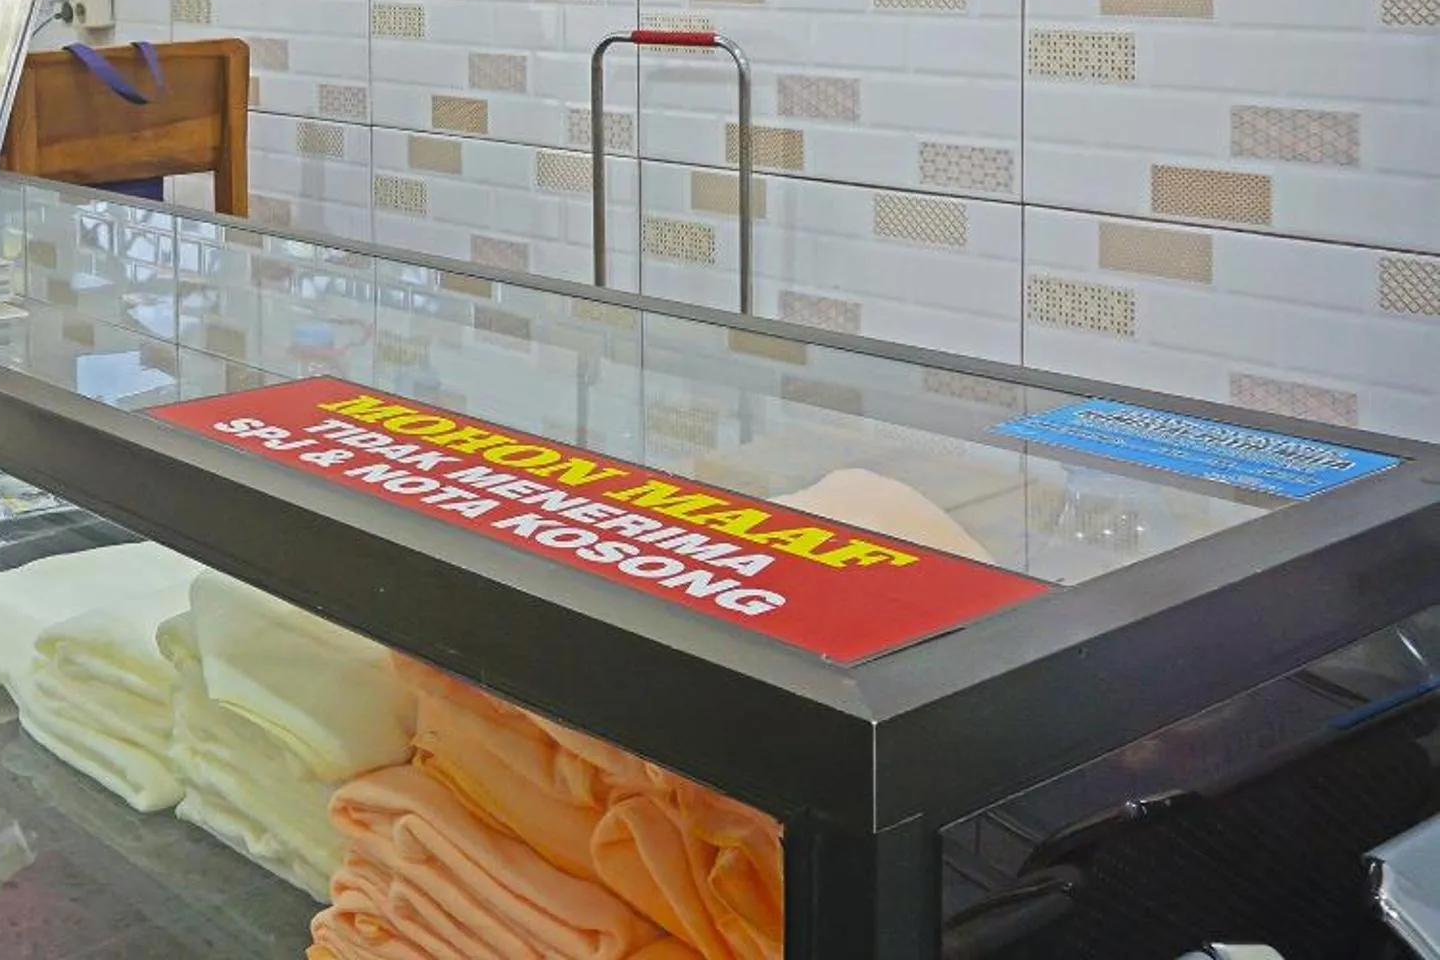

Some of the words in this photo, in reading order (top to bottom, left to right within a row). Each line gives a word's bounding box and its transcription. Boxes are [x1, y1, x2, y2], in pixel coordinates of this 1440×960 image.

[212, 417, 318, 451] SPJ
[298, 447, 356, 468] &
[343, 463, 501, 520] NOTA
[490, 512, 787, 617] KOSONG
[302, 418, 463, 471] TIDAK
[443, 465, 777, 578] MENERIMA
[317, 394, 630, 487] MOHON
[605, 479, 921, 569] MAAF
